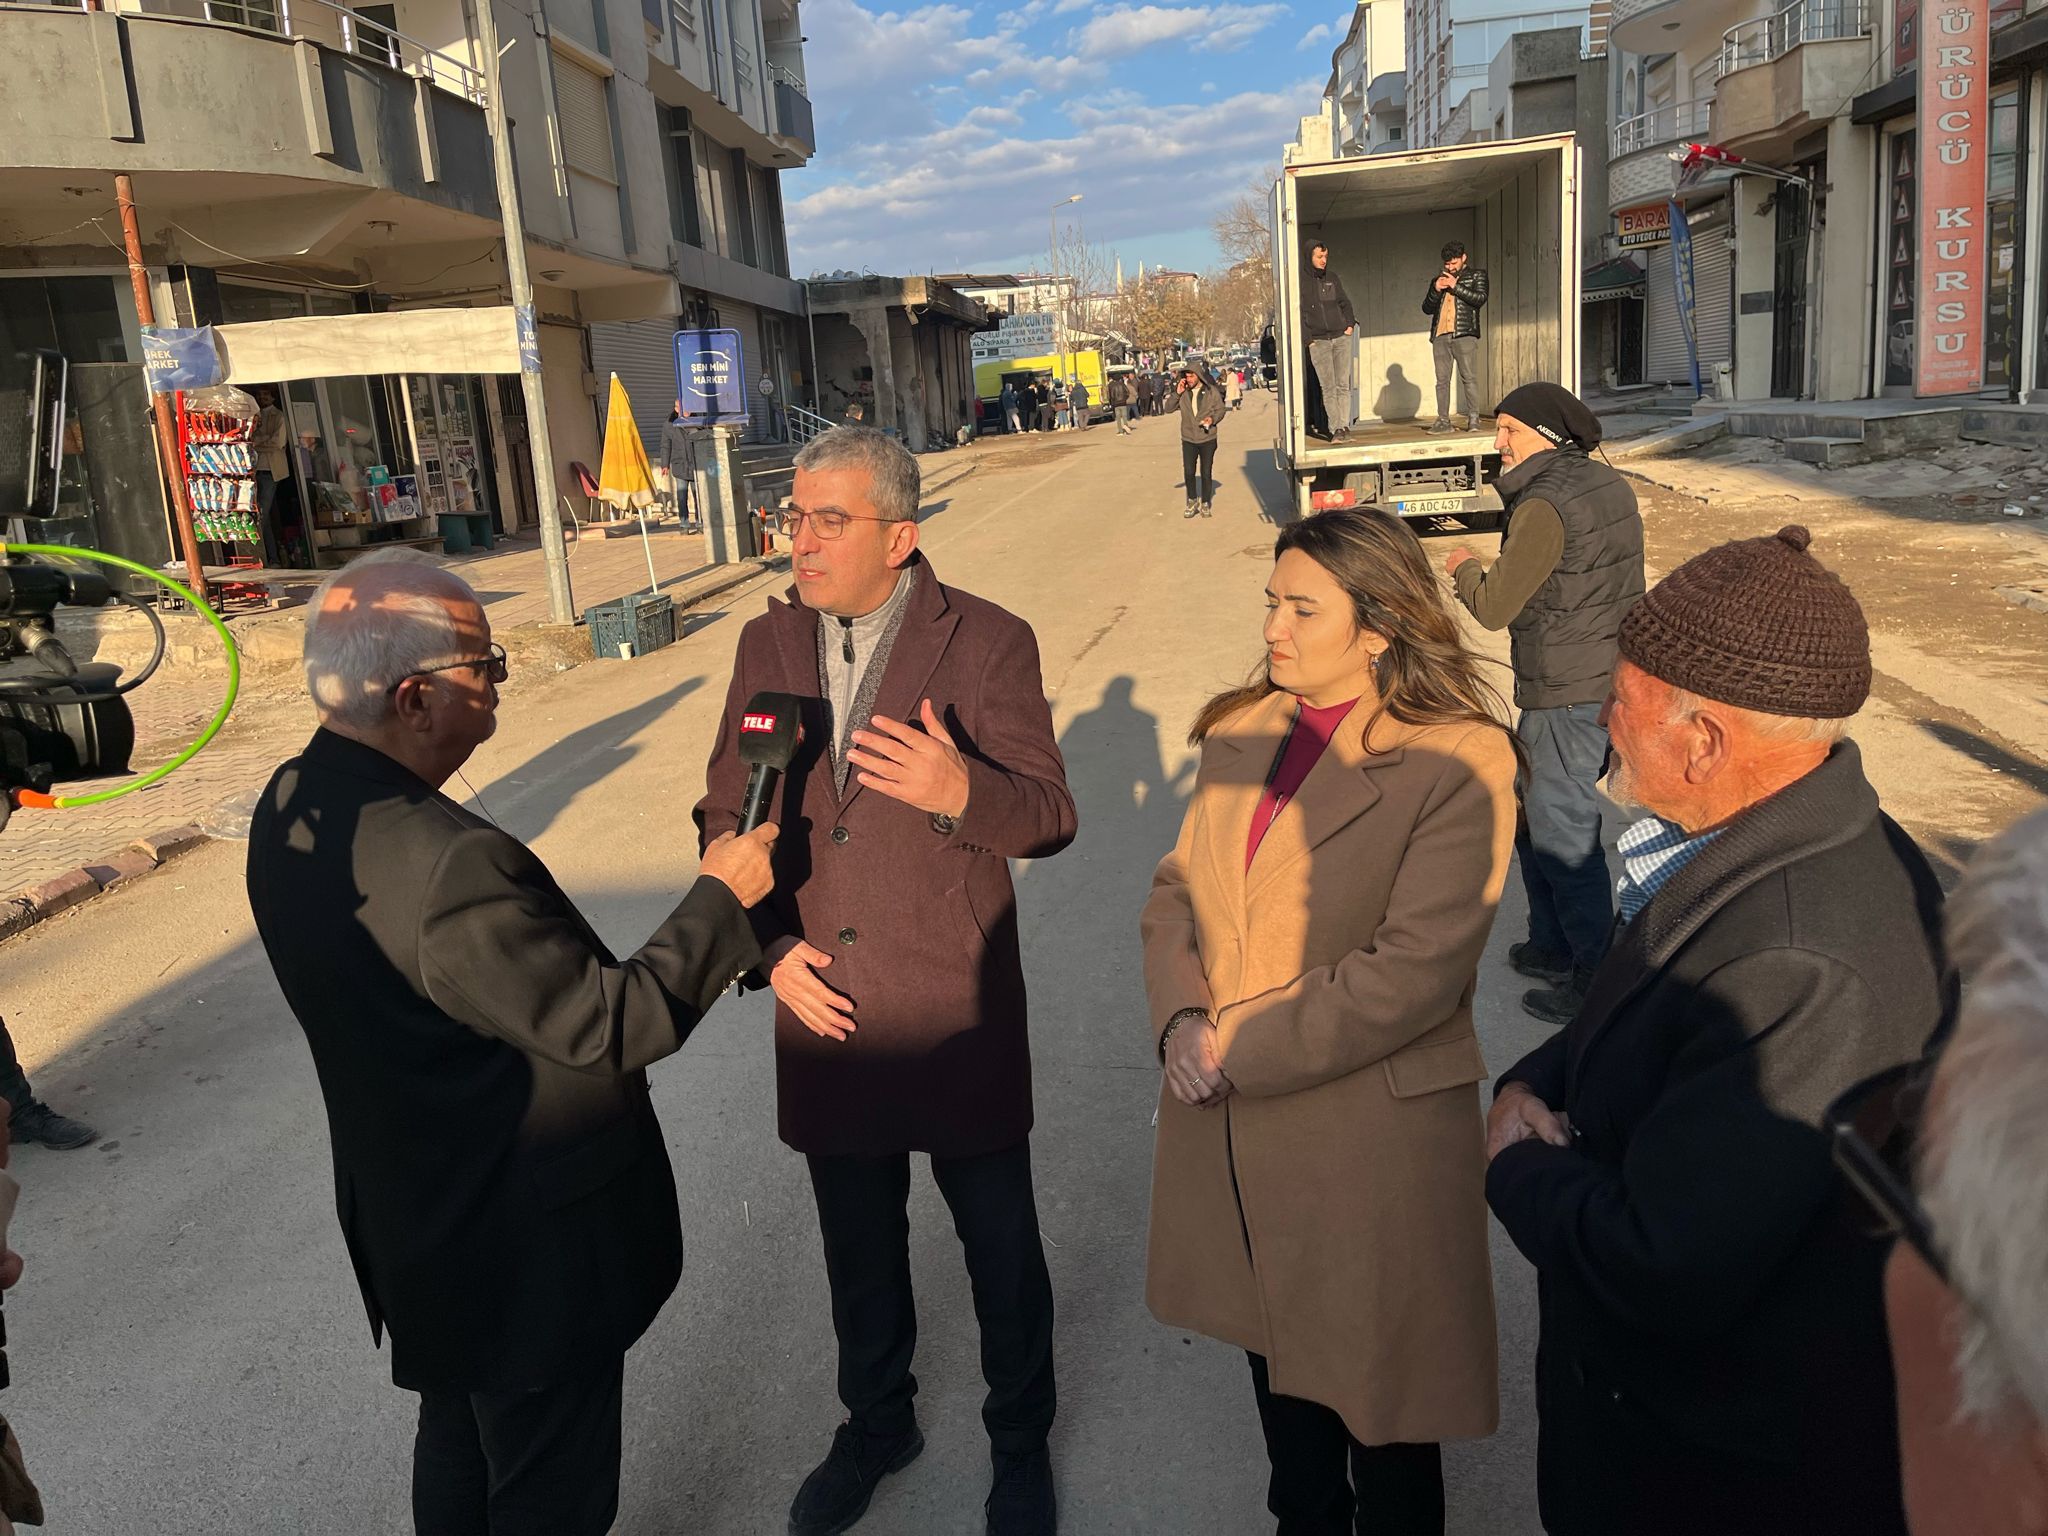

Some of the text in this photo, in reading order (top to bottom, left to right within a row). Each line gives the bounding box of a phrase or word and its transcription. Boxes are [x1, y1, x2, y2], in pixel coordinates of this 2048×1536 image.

[1937, 0, 1976, 165] ÜRÜCÜ
[1622, 235, 1637, 245] OTO
[1636, 231, 1656, 243] YEDEK
[1935, 207, 1972, 354] KURSU
[690, 360, 729, 374] ŞEN MİNİ
[693, 375, 728, 384] MARKET
[1404, 499, 1461, 513] 46 ADC 437
[743, 716, 774, 730] TELE
